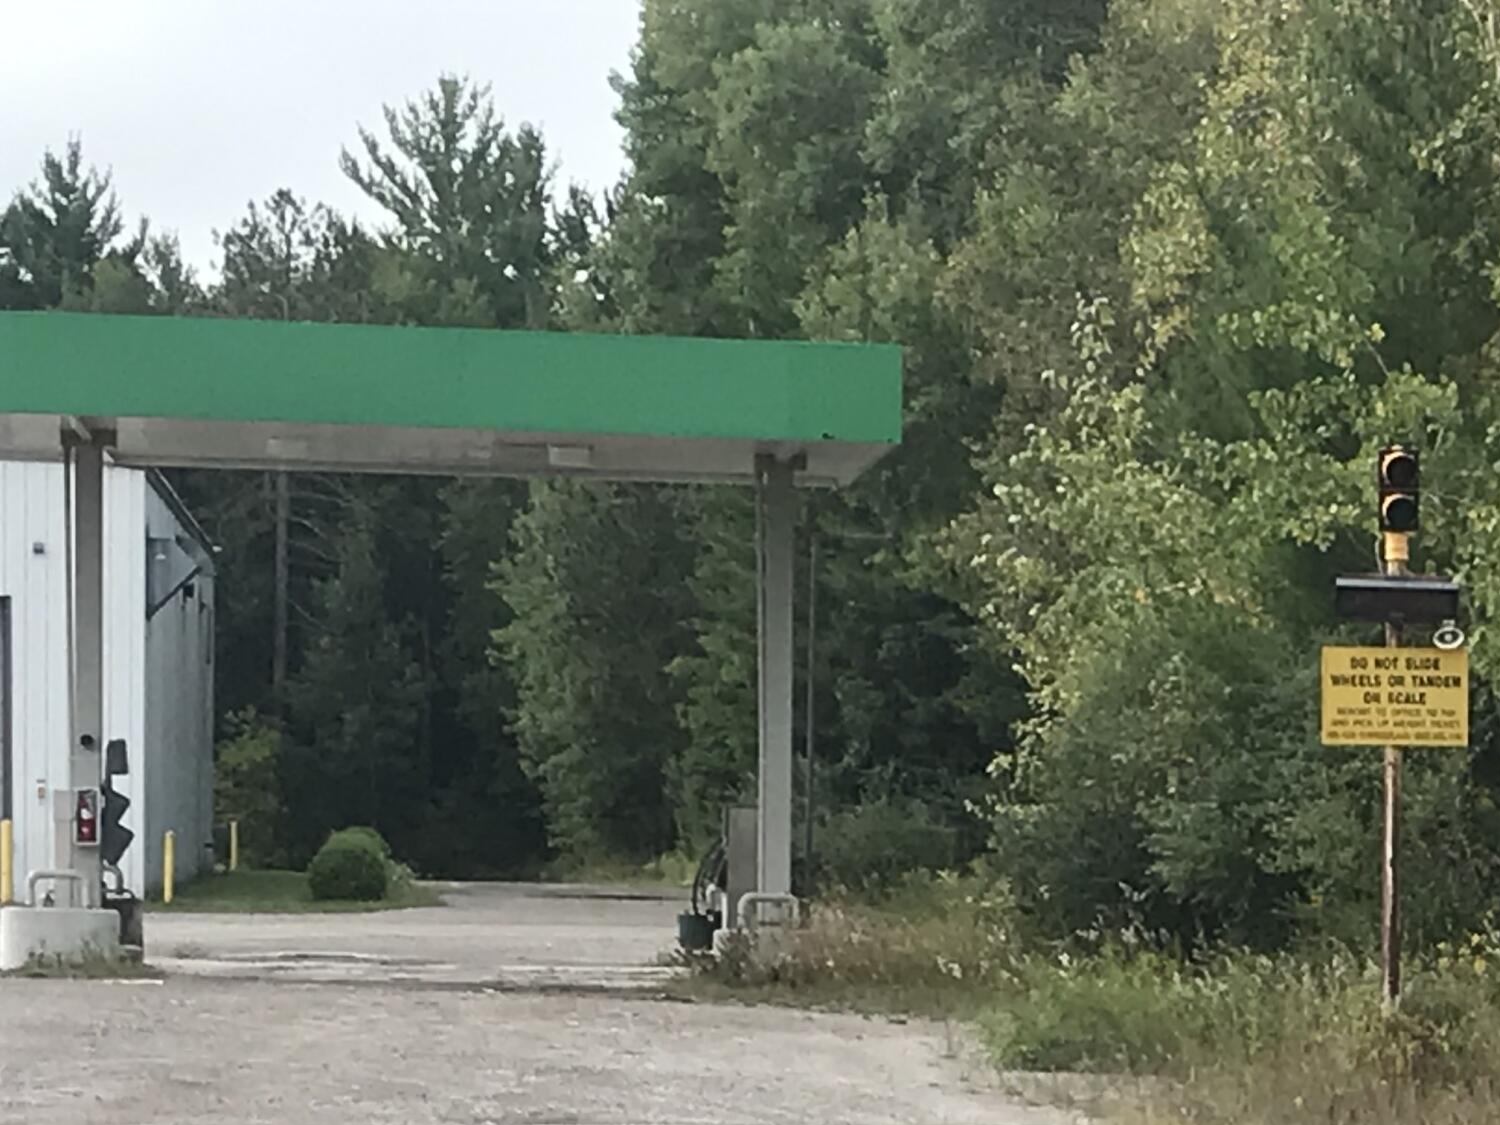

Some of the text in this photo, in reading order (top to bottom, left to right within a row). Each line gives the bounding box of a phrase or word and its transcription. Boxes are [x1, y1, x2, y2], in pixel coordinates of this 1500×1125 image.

[1350, 656, 1440, 670] DO NOT SLIDE
[1330, 674, 1461, 688] WHEELS OR TANDEM
[1388, 692, 1426, 705] SCALE
